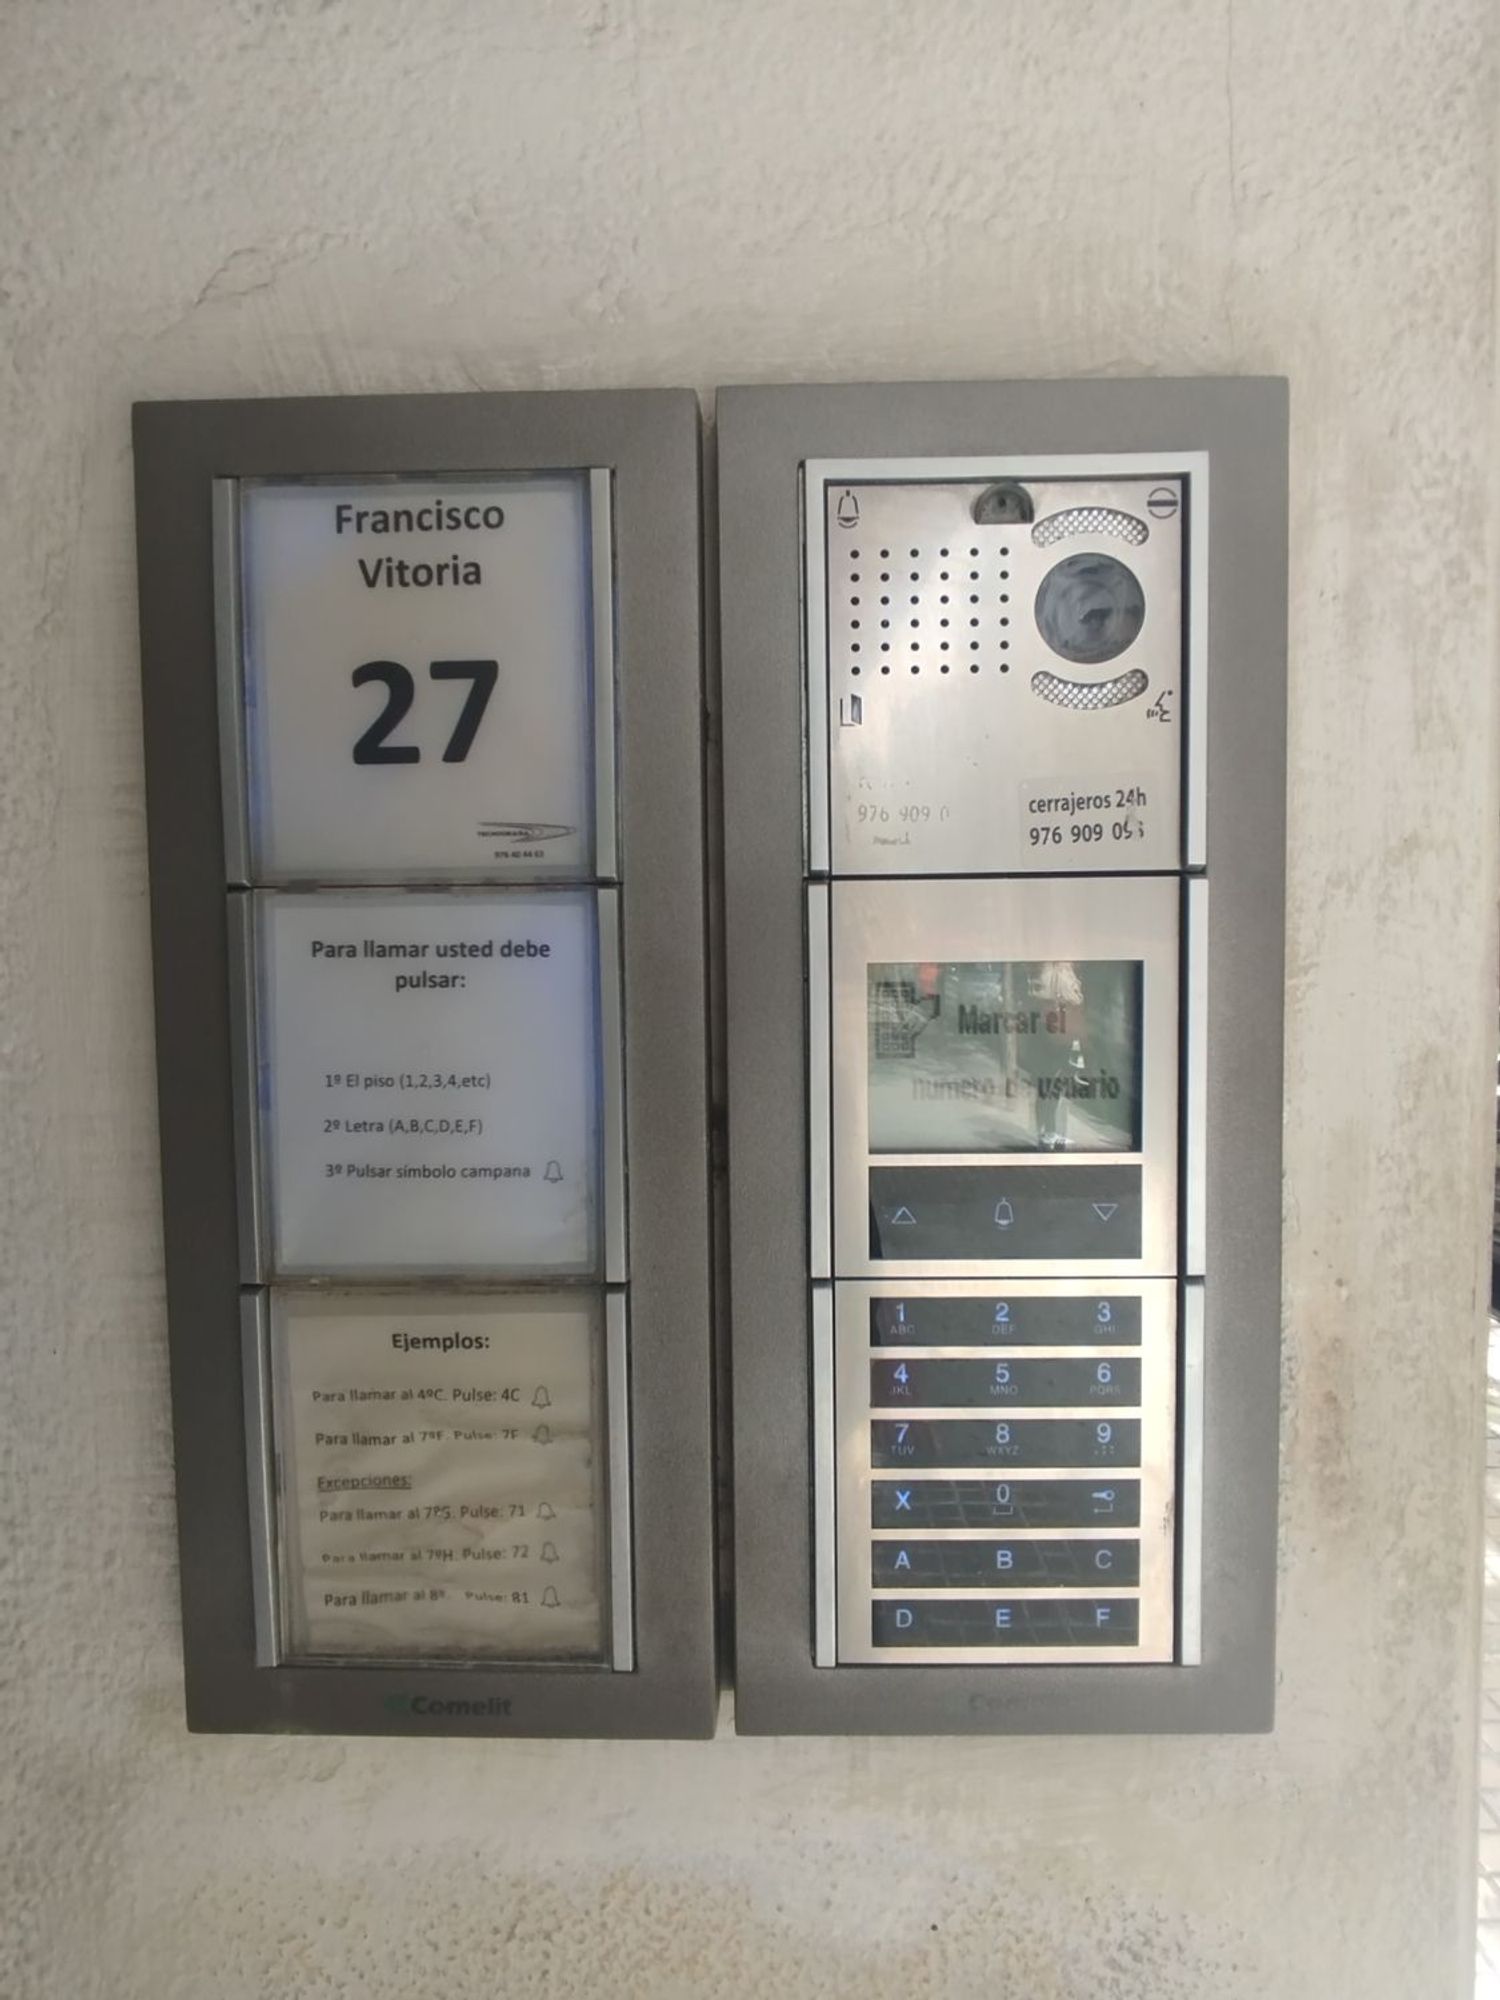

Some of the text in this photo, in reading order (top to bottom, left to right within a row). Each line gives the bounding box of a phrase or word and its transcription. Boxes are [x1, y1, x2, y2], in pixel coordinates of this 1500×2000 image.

[335, 500, 504, 534] Francisco
[358, 555, 482, 588] Vitoria
[352, 659, 499, 764] 27
[1029, 786, 1147, 817] cerrajeros 24h
[857, 804, 889, 822] 976
[1029, 826, 1062, 846] 976
[1071, 823, 1103, 844] 909
[312, 940, 551, 958] Para llamar usted debe
[395, 971, 466, 992] pulsar:
[958, 1004, 1067, 1035] Marcar el
[325, 1073, 491, 1092] 1º El piso (1,2,3,4,etc)
[323, 1118, 484, 1136] 2º Letra (A,B,C,D,E,F)
[325, 1163, 343, 1178] 3º
[347, 1163, 392, 1179] Pulsar
[460, 1166, 531, 1183] campana
[895, 1302, 905, 1322] 1
[995, 1302, 1010, 1322] 2
[1097, 1301, 1111, 1322] 3
[890, 1325, 916, 1334] ABC
[991, 1325, 1016, 1334] DEF
[391, 1332, 490, 1352] Ejemplos:
[893, 1362, 909, 1383] 4
[995, 1363, 1010, 1383] 5
[1097, 1362, 1111, 1383] 6
[312, 1390, 346, 1403] Para
[349, 1388, 396, 1401] llamar
[400, 1389, 414, 1401] al
[452, 1387, 497, 1402] Pulse:
[501, 1388, 520, 1402] 4C
[990, 1385, 1018, 1395] MNO
[315, 1432, 348, 1446] Para
[352, 1432, 396, 1446] llamar
[402, 1431, 415, 1444] al
[502, 1428, 519, 1440] 7F
[895, 1423, 909, 1443] 7
[996, 1423, 1010, 1443] 8
[1097, 1423, 1111, 1443] 9
[891, 1446, 915, 1455] TUV
[317, 1473, 412, 1492] Excepciones:
[895, 1490, 911, 1511] X
[996, 1484, 1010, 1504] 0
[320, 1509, 352, 1522] Para
[356, 1507, 402, 1521] llamar
[407, 1507, 420, 1520] al
[460, 1505, 504, 1519] Pulse:
[509, 1504, 525, 1517] 71
[322, 1552, 355, 1563] Para
[359, 1551, 404, 1562] llamar
[410, 1550, 422, 1561] al
[462, 1547, 507, 1560] Pulse:
[512, 1544, 529, 1558] 72
[894, 1551, 911, 1569] A
[996, 1550, 1013, 1569] B
[1095, 1550, 1113, 1569] C
[324, 1593, 357, 1607] Para
[361, 1589, 407, 1605] llamar
[413, 1589, 425, 1601] al
[895, 1609, 913, 1628] D
[995, 1609, 1011, 1628] E
[1096, 1608, 1111, 1627] F
[410, 1696, 513, 1716] Comelit
